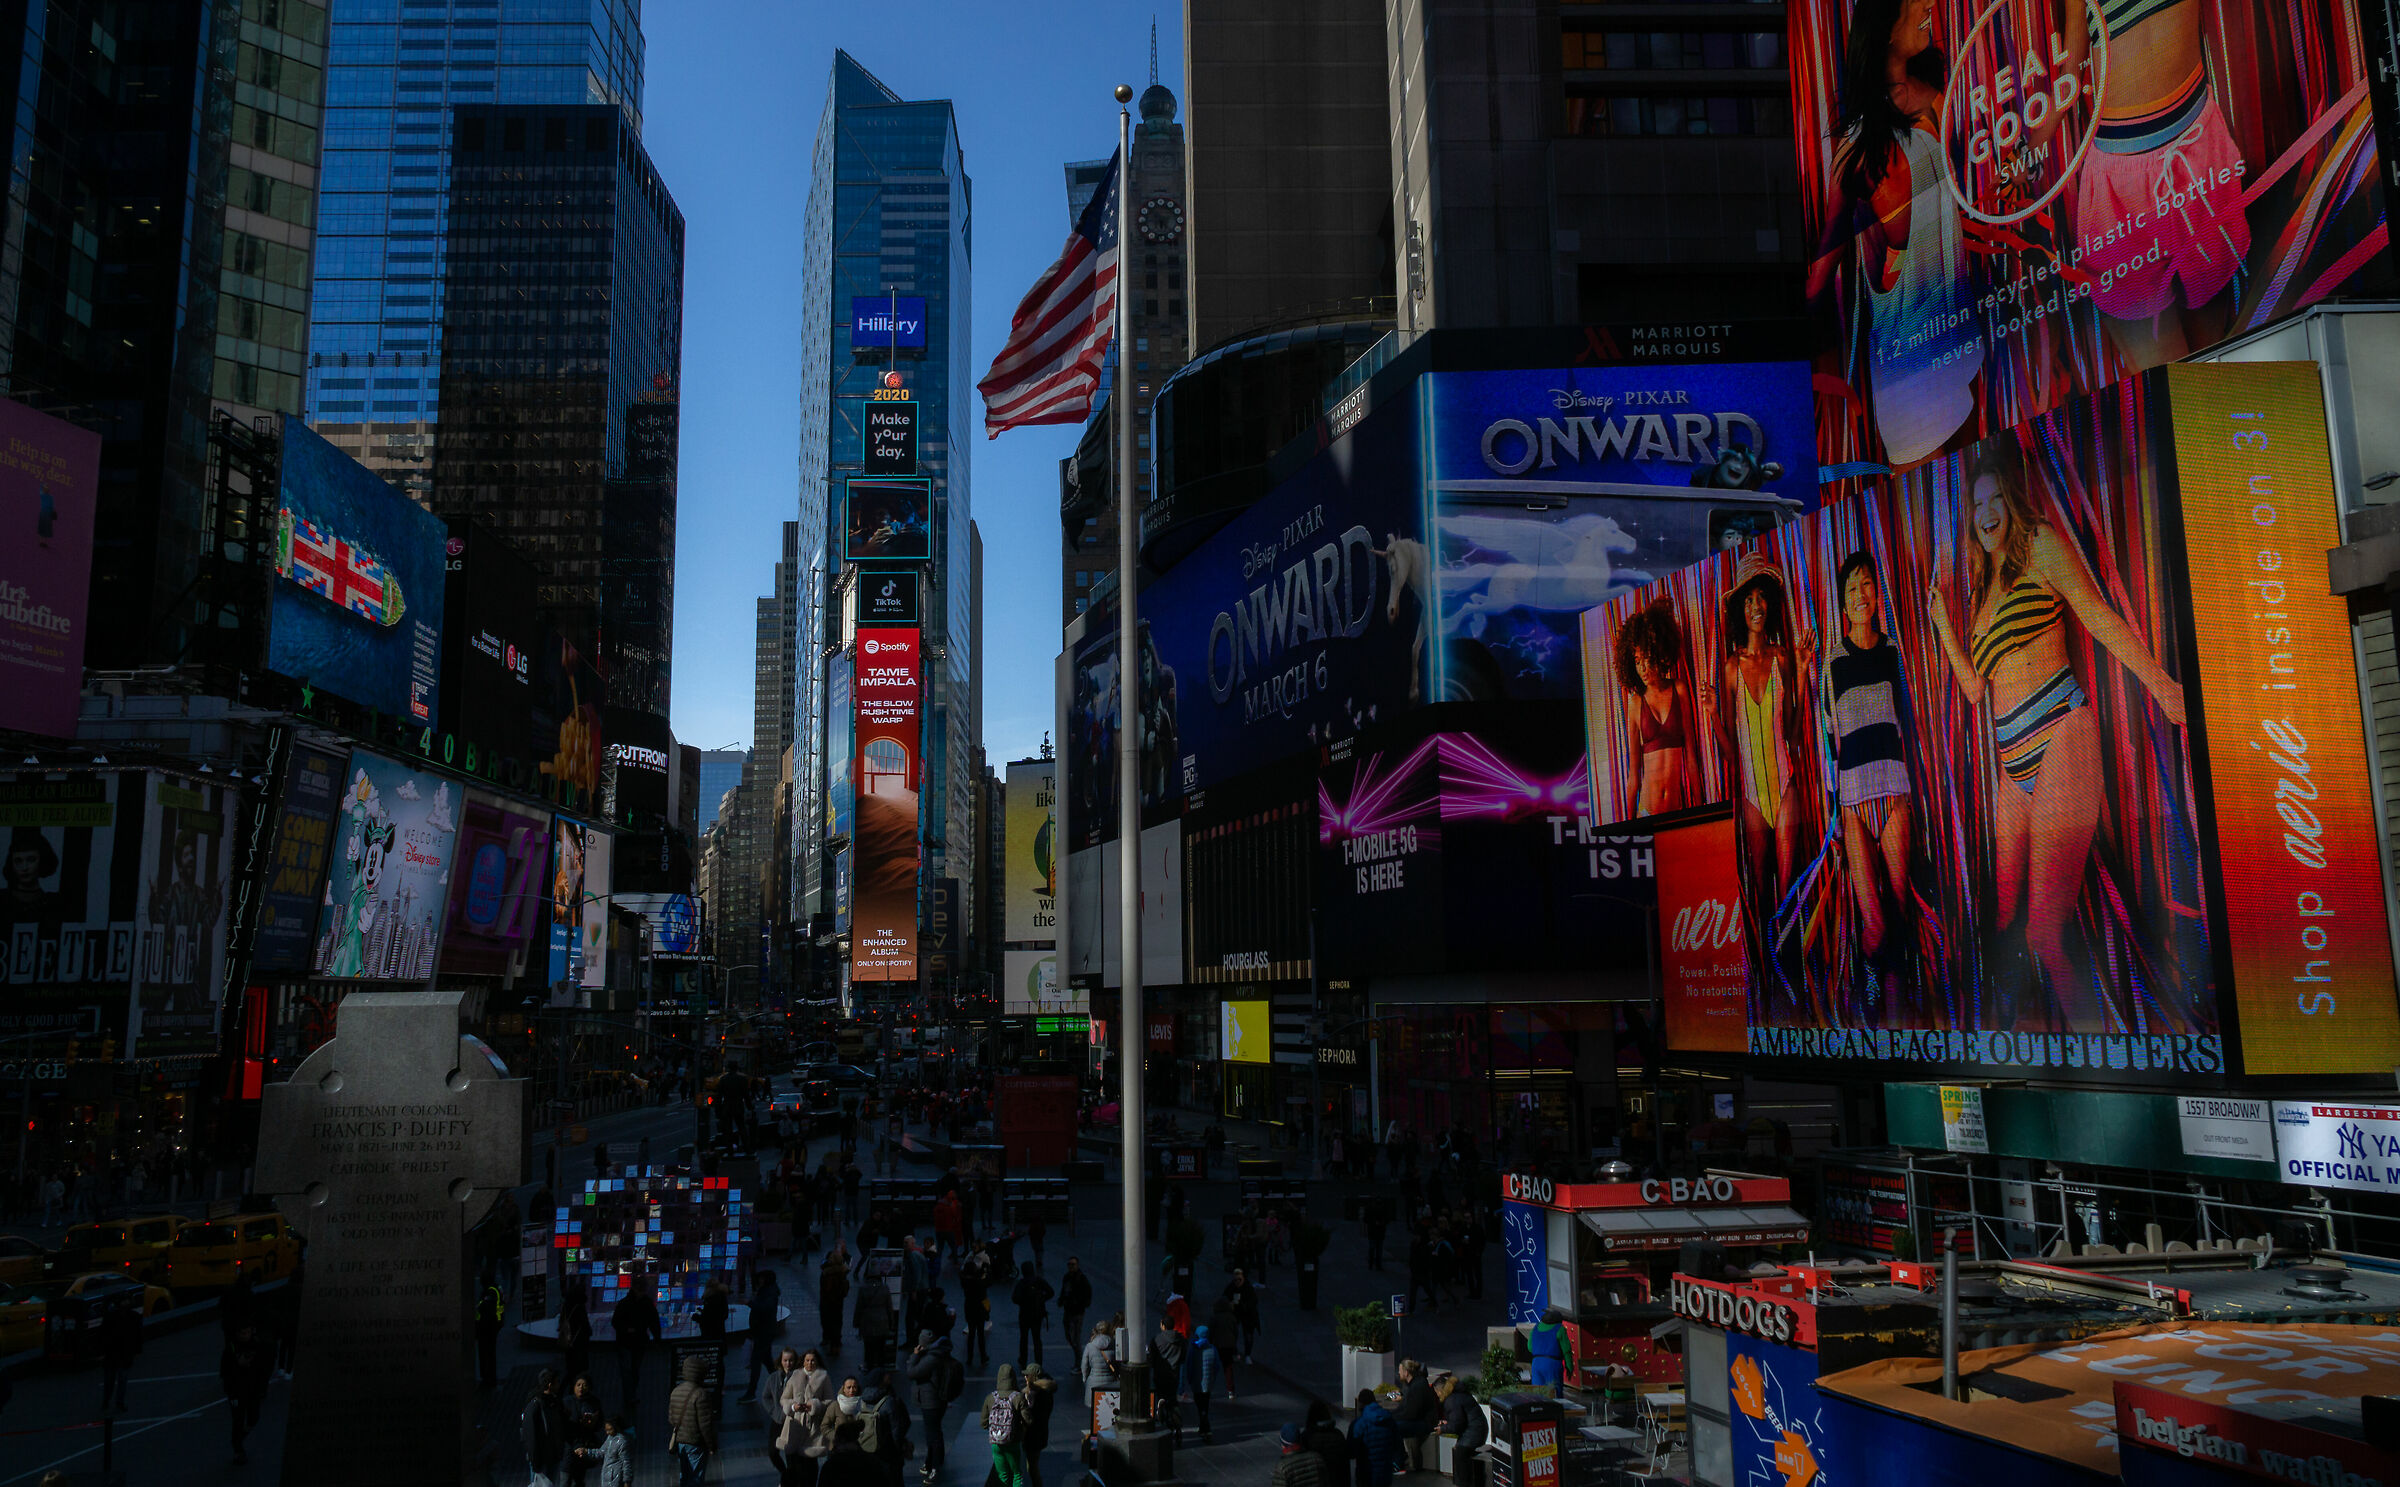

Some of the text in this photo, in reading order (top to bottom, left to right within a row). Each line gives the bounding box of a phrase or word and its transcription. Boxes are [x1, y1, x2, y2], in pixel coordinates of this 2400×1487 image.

[1969, 32, 2071, 121] REAL
[1970, 73, 2092, 164] GOOD.
[2001, 141, 2049, 185] SWIM
[1875, 157, 2246, 366] 1.2 million recycled plastic bottles
[1932, 237, 2170, 371] never looked so good.
[858, 316, 918, 336] Hillary
[1631, 325, 1734, 341] MARRIOTT
[1632, 342, 1722, 357] MARQUIS
[874, 389, 909, 401] 2020
[1331, 388, 1366, 424] MARRIOTT
[1624, 390, 1689, 406] PIXAR
[871, 412, 911, 426] Make
[1331, 407, 1361, 439] MARQUIS
[874, 428, 907, 446] your
[1480, 411, 1765, 477] ONWARD
[876, 444, 905, 461] day.
[2247, 473, 2278, 529] on
[1282, 503, 1325, 552] PIXAR
[445, 560, 463, 571] LG
[874, 598, 902, 607] TikTok
[1208, 523, 1377, 705] ONWARD
[2247, 547, 2297, 692] inside
[880, 642, 911, 652] Spotify
[516, 650, 528, 675] LG
[868, 667, 910, 677] TAME
[860, 678, 917, 687] IMPALA
[1244, 648, 1329, 726] MARCH 6
[414, 702, 429, 718] GREAT
[861, 700, 914, 708] THE SLOW
[610, 743, 669, 769] OUTFRONT
[1183, 764, 1195, 785] PG
[2250, 716, 2328, 869] aerie
[245, 802, 267, 873] MAC
[282, 813, 328, 846] COME
[1342, 824, 1418, 865] T-MOBILE 5G
[1587, 850, 1622, 879] IS
[270, 866, 320, 898] AWAY
[1356, 860, 1405, 895] IS HERE
[229, 880, 251, 950] MAC
[862, 939, 907, 947] ENHANCED
[877, 929, 893, 937] THE
[870, 948, 899, 956] ALBUM
[1222, 949, 1269, 971] HOURGLASS
[1679, 965, 1711, 979] Power.
[1329, 980, 1351, 990] SEPHORA
[1686, 984, 1700, 997] No
[1317, 1047, 1357, 1065] SEPHORA
[1748, 1026, 2222, 1074] AMERICAN EAGLE OUTFITTERS
[1943, 1090, 1980, 1102] SPRING
[323, 1103, 460, 1119] LIEUTENANT COLONEL
[2185, 1100, 2261, 1119] 1557 BROADWAY
[2316, 1107, 2378, 1119] LARGEST
[312, 1120, 473, 1139] FRANCIS DUFFY
[436, 1140, 462, 1151] 1932
[330, 1160, 450, 1175] CATHOLIC PRIEST
[2288, 1159, 2380, 1183] OFFICIAL
[1509, 1172, 1553, 1203] C BAO
[1641, 1176, 1735, 1203] C BAO
[1871, 1175, 1906, 1191] proud
[356, 1192, 420, 1205] CHAPLAIN
[1670, 1279, 1791, 1342] HOTDOGS
[1735, 1366, 1758, 1408] LOCAL
[1764, 1403, 1784, 1433] BEER
[1521, 1426, 1557, 1452] JERSEY
[2133, 1406, 2250, 1464] belgian
[1528, 1455, 1555, 1478] BOYS
